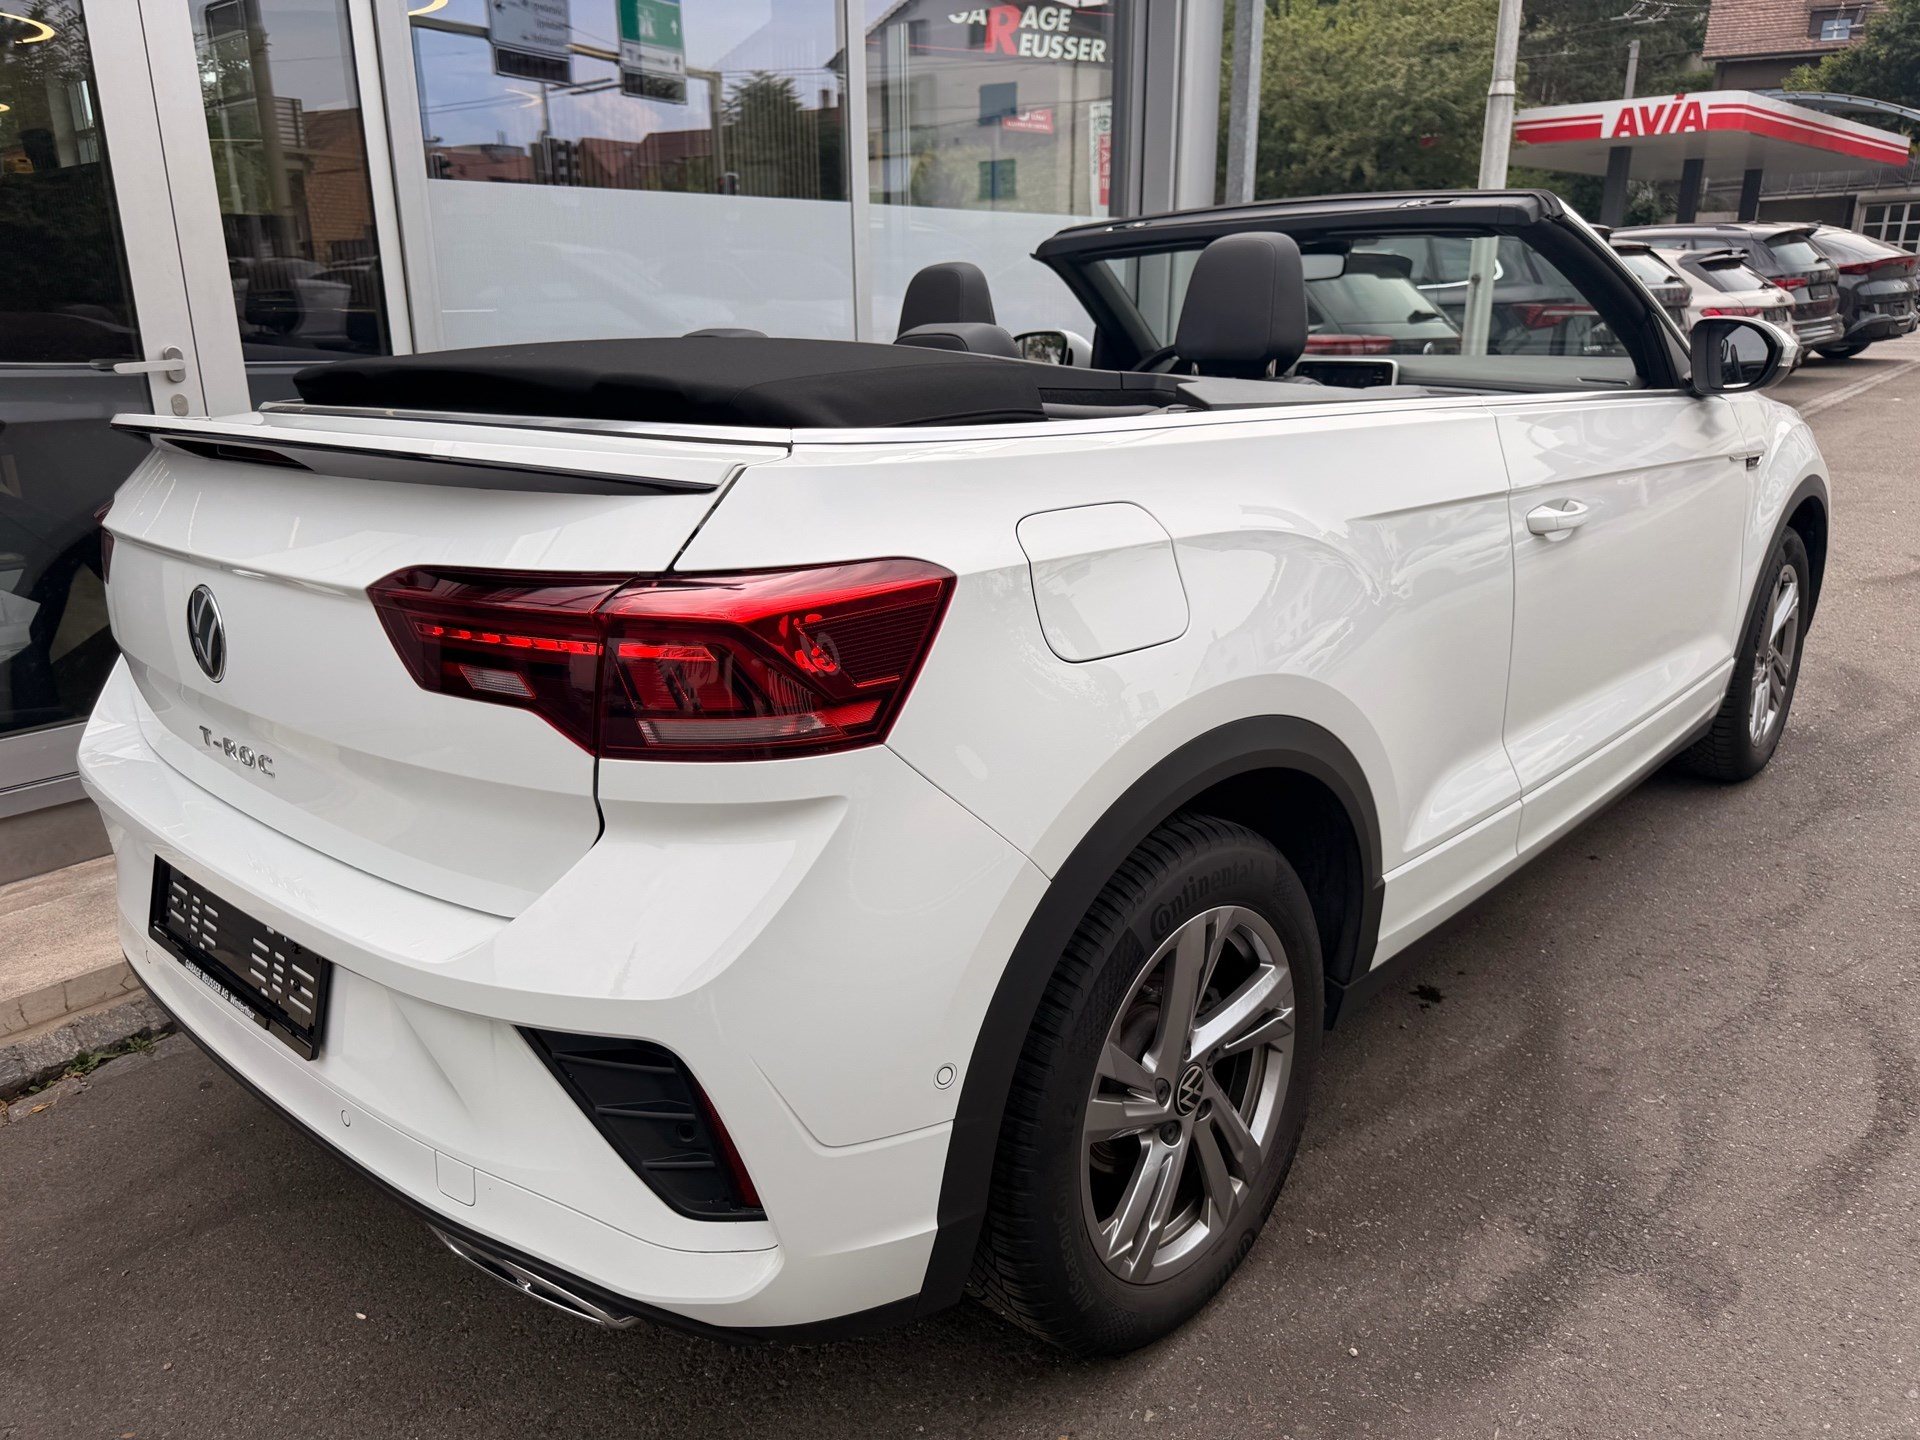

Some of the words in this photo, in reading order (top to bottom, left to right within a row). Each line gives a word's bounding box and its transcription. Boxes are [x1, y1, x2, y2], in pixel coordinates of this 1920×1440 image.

[1611, 93, 1704, 138] AVIA
[199, 725, 275, 779] T-ROC
[1150, 858, 1255, 941] Continental
[185, 959, 202, 979] GARAGE
[202, 972, 221, 995] REUSSER
[220, 987, 229, 1000] AG
